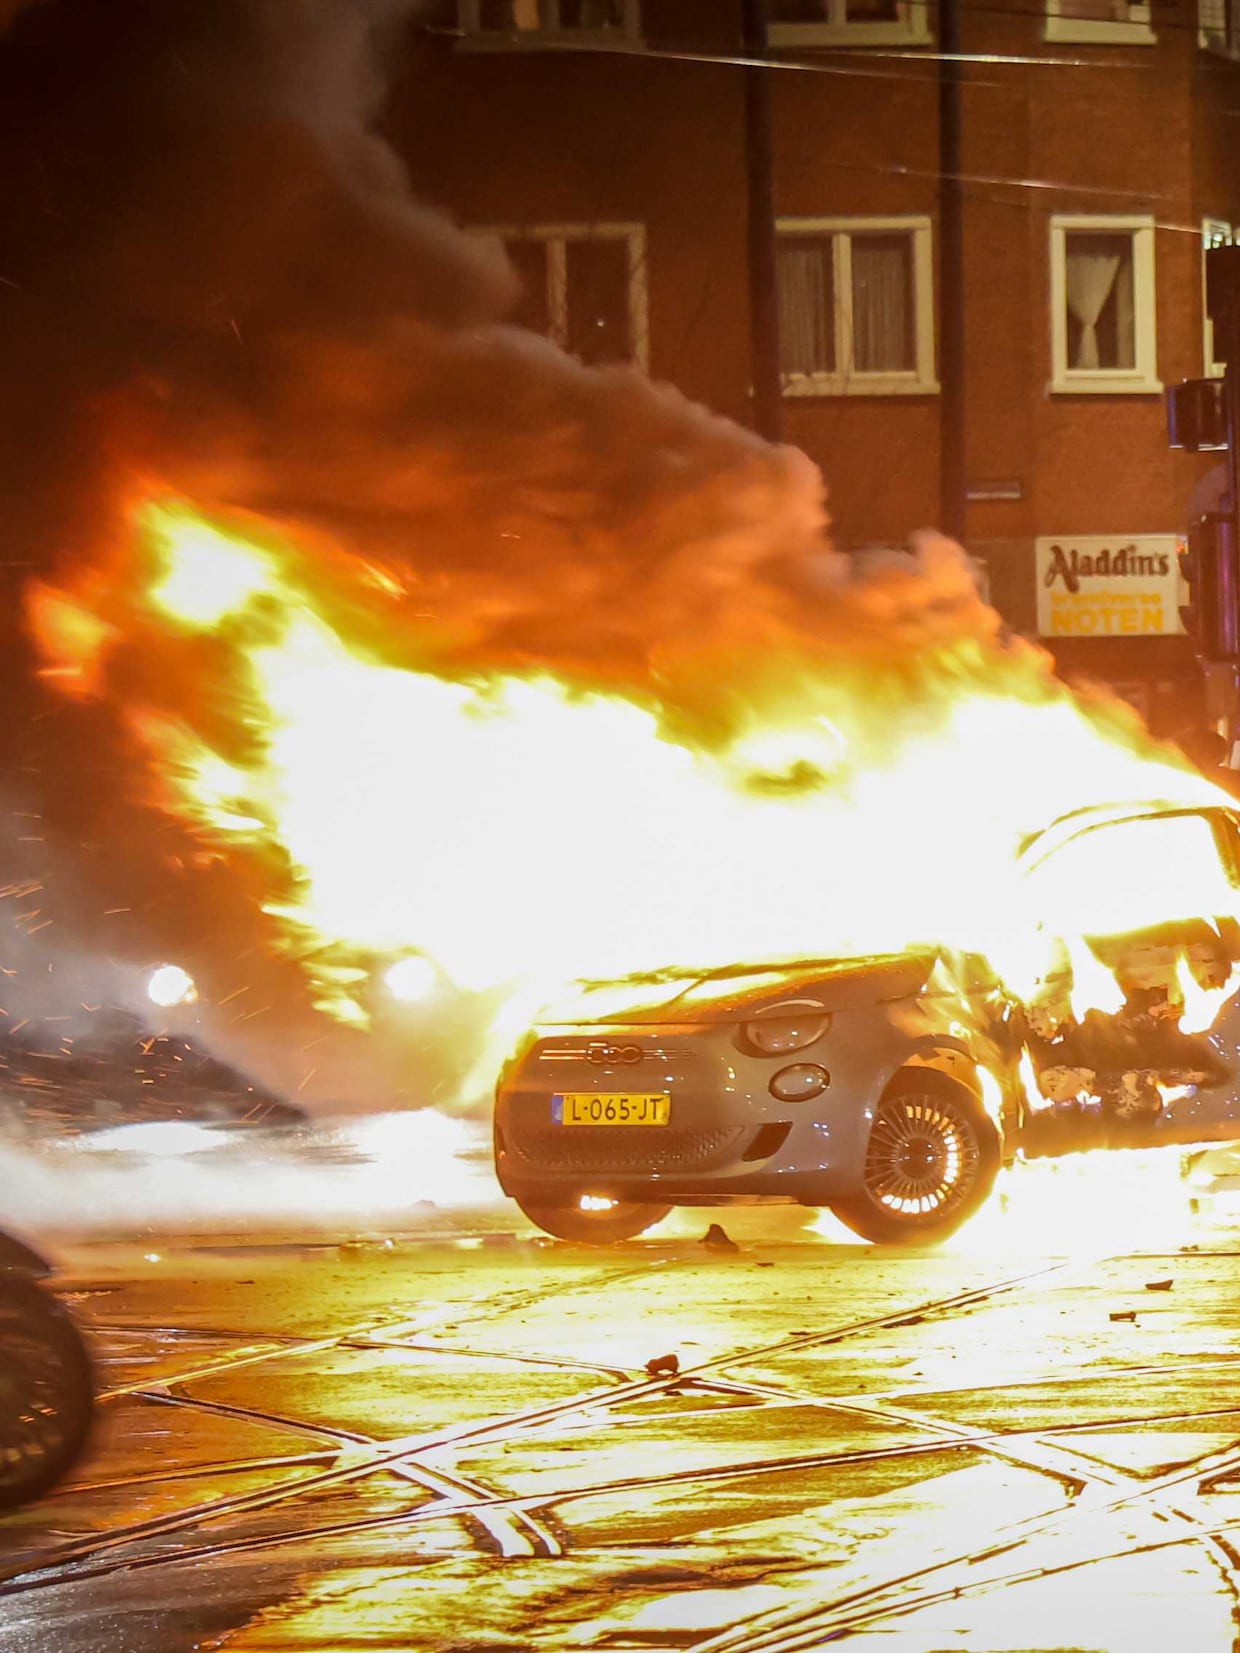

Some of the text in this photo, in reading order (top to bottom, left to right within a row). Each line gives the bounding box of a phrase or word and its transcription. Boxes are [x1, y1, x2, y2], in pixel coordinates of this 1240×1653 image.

[1044, 544, 1169, 594] Aladdin's
[1052, 608, 1163, 633] NOTEN
[572, 1098, 664, 1121] L-065-JT
